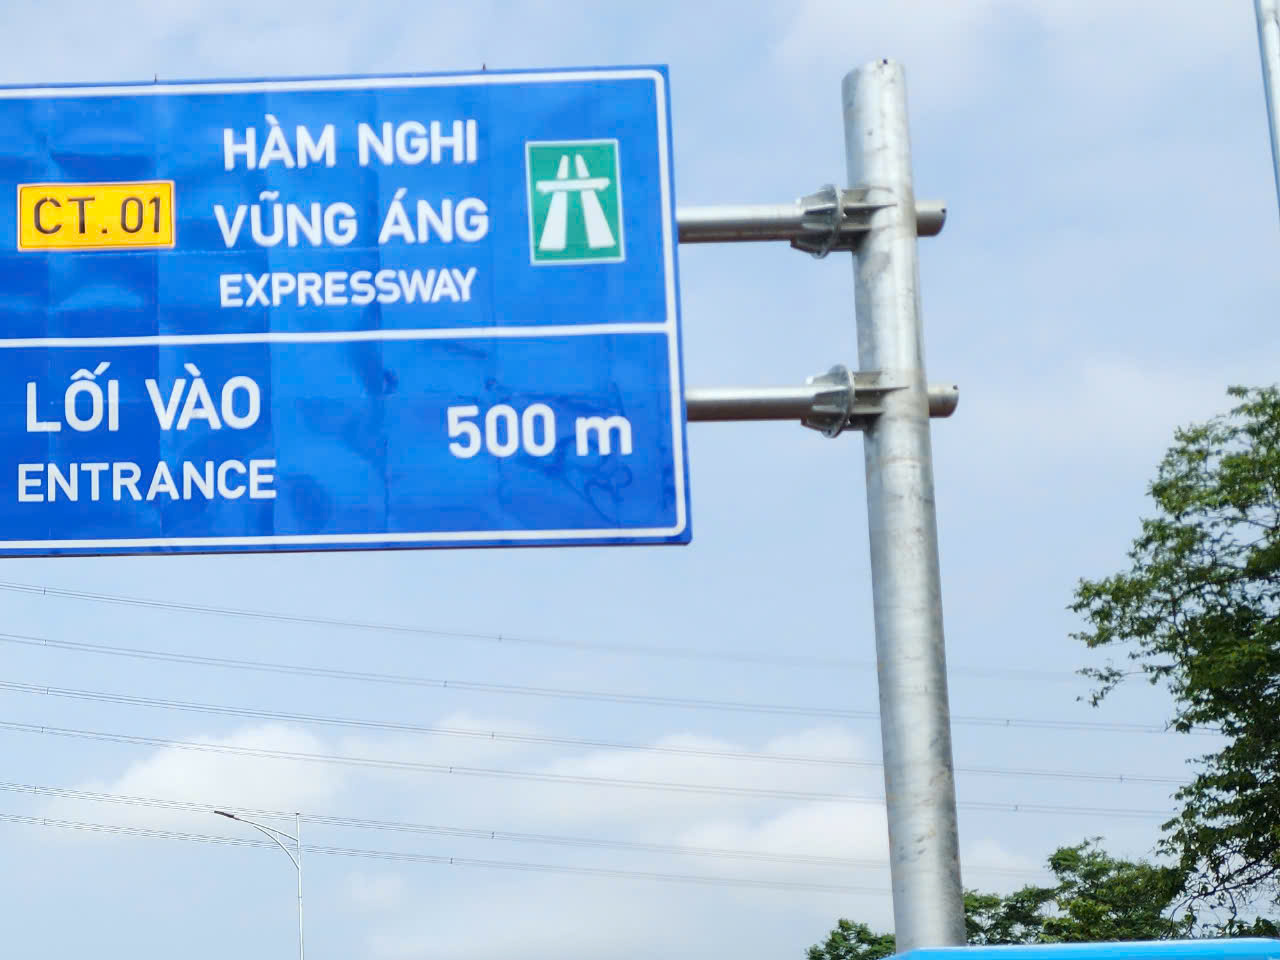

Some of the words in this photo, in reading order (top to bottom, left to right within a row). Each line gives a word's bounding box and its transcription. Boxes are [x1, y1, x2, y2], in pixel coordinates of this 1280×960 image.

[223, 113, 336, 171] HÀM
[357, 119, 477, 166] NGHI
[33, 196, 161, 235] CT.01
[213, 190, 358, 248] VŨNG
[377, 187, 489, 244] ÁNG
[219, 267, 477, 308] EXPRESSWAY
[26, 361, 119, 432] LỐI
[144, 363, 261, 431] VÀO
[447, 403, 556, 459] 500
[575, 415, 633, 456] m
[18, 459, 277, 502] ENTRANCE
